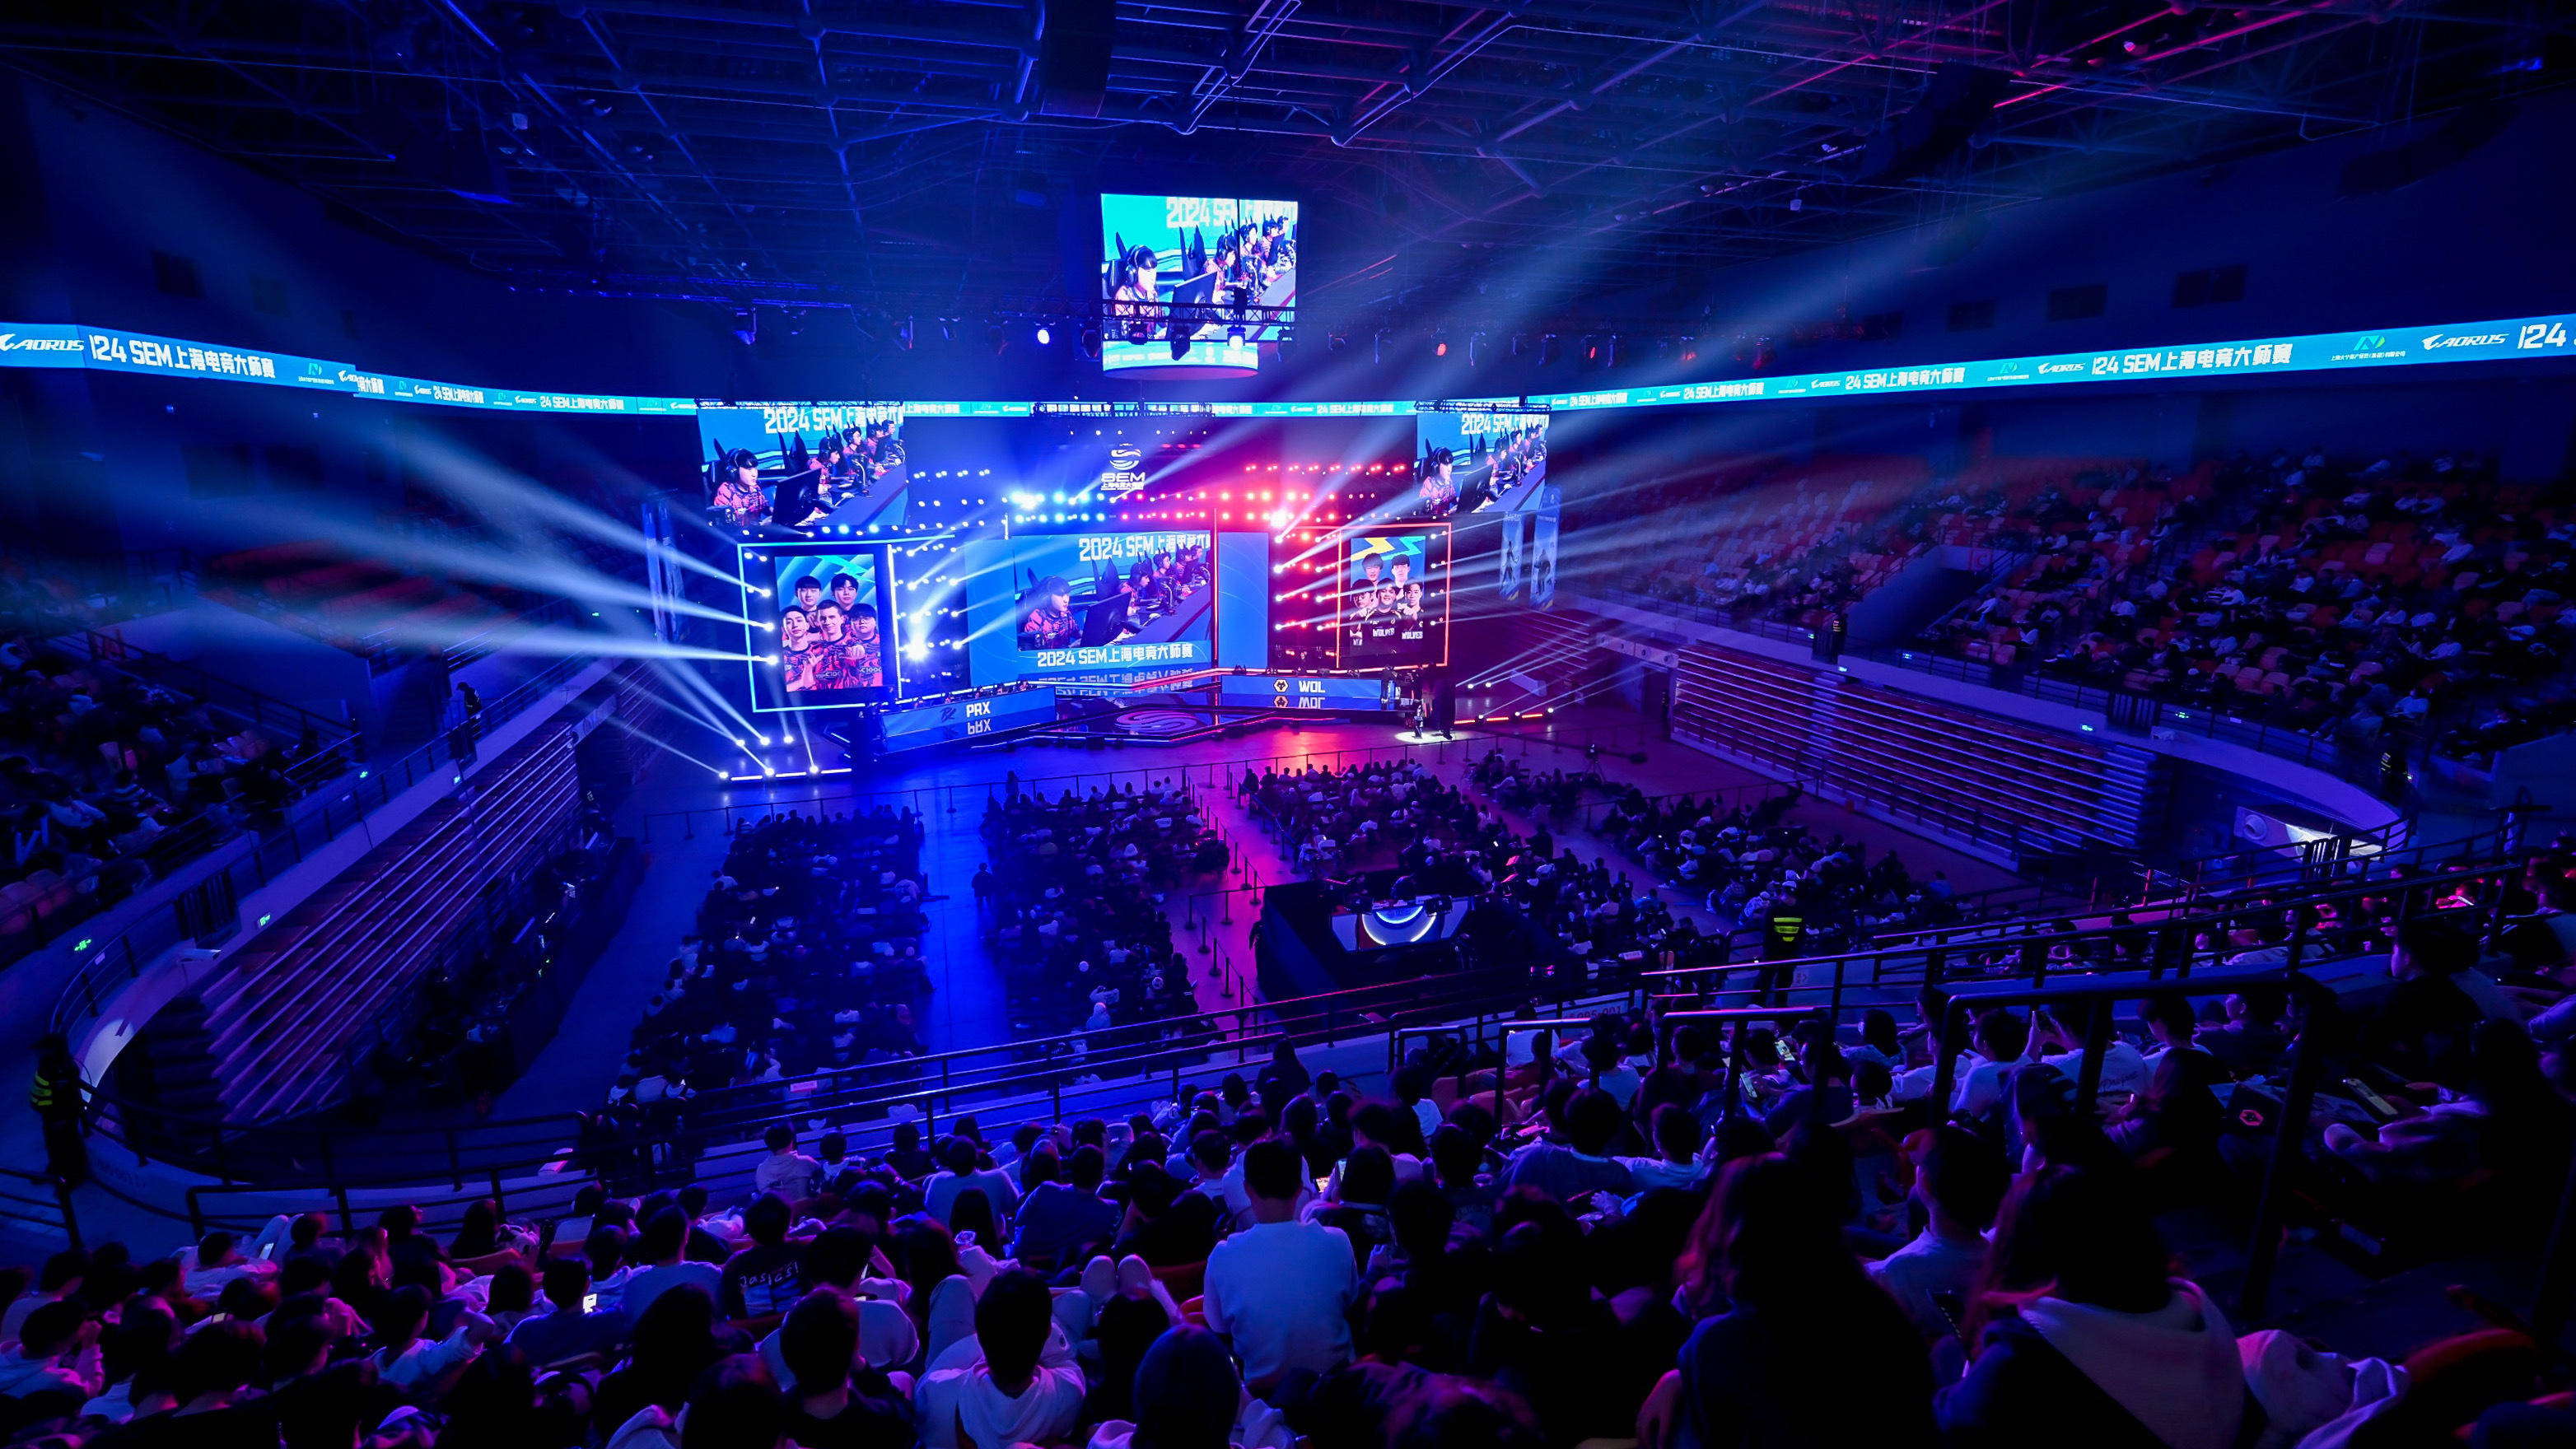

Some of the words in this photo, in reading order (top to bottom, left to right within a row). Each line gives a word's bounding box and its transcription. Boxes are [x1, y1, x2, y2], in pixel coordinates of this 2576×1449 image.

[1166, 197, 1210, 228] 2024
[12, 339, 85, 351] AORUS
[2436, 333, 2510, 347] AORUS
[2051, 362, 2087, 373] AORUS
[764, 407, 810, 434] 2024
[1461, 412, 1491, 435] 2024
[1079, 537, 1122, 561] 2024
[1037, 650, 1076, 667] 2024
[1299, 681, 1326, 693] WOL
[966, 701, 991, 718] PRX
